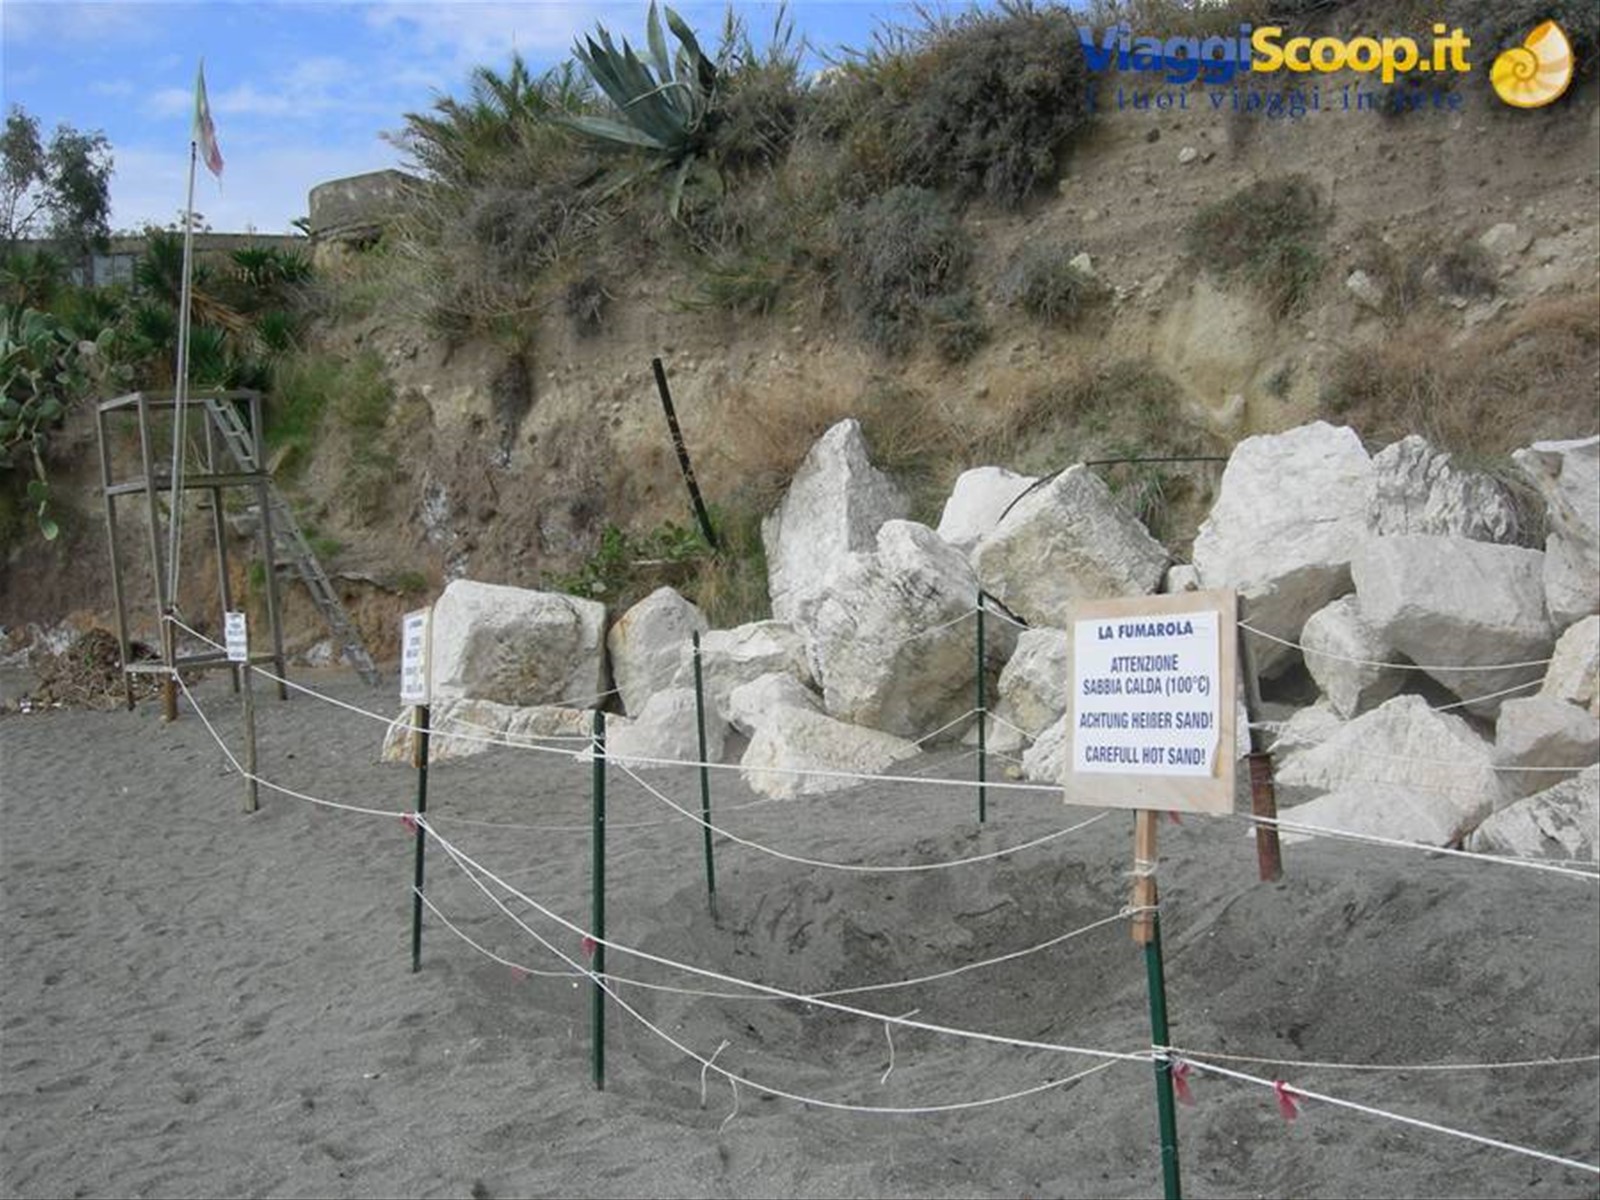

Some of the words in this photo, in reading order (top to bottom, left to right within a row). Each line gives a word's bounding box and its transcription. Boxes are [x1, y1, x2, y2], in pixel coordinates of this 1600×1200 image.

[1098, 626, 1114, 640] LA
[1118, 621, 1193, 639] FUMAROLA
[1110, 654, 1179, 673] ATTENZIONE
[1083, 678, 1122, 695] SABBIA
[1125, 677, 1162, 695] CALDA
[1165, 675, 1210, 697] (100°C)
[1080, 712, 1129, 729] ACHTUNG
[1175, 711, 1213, 729] SAND!
[1085, 746, 1140, 764] CAREFULL
[1142, 747, 1164, 764] HOT
[1168, 748, 1206, 765] SAND!
